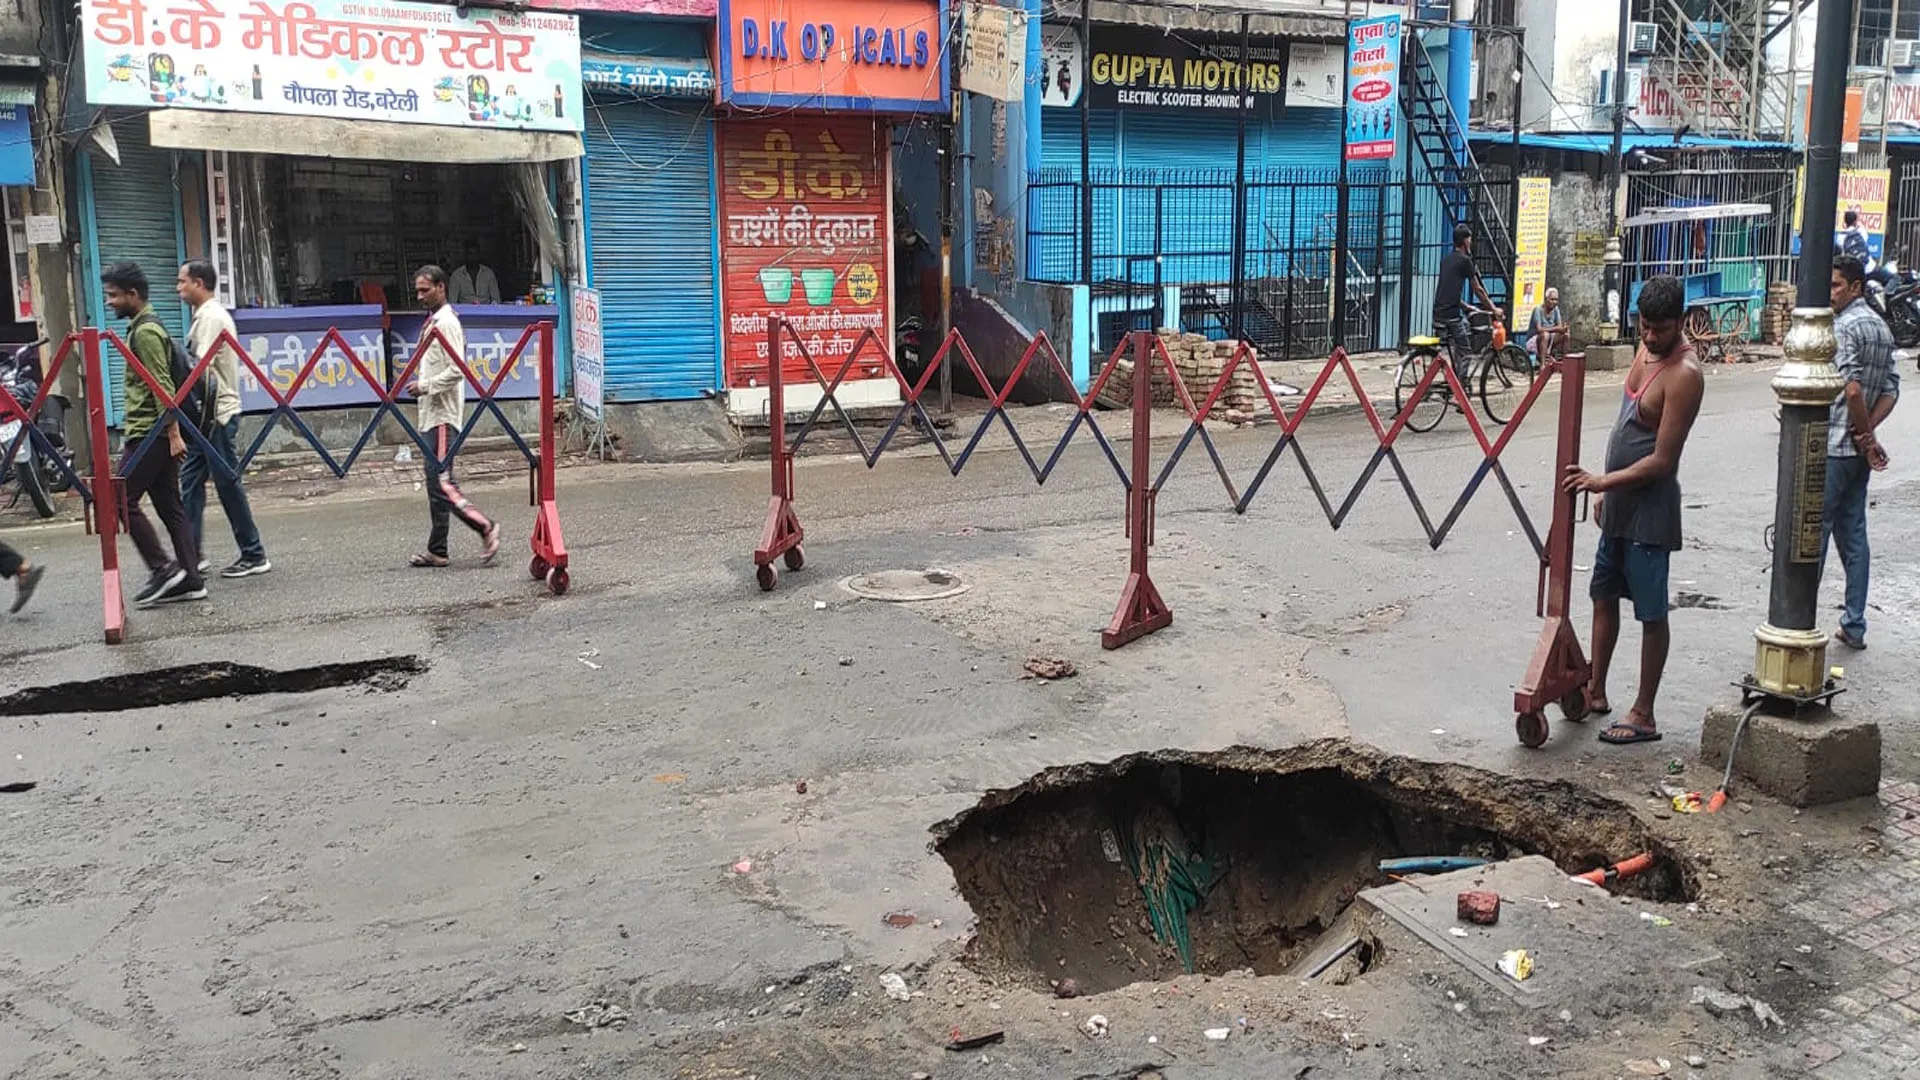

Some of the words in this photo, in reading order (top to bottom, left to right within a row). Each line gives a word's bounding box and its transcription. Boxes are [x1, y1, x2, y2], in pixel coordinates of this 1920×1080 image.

[239, 2, 428, 66] मेडिकल
[436, 20, 535, 73] स्टोर
[742, 18, 789, 61] D.K
[801, 23, 929, 68] OPICALS
[1353, 24, 1384, 45] गुप्ता
[1353, 45, 1386, 63] मोटर्स
[1092, 53, 1176, 89] GUPTA
[1183, 58, 1281, 93] MOTORS
[282, 80, 338, 106] चौपला
[1118, 90, 1160, 105] ELECTRIC
[1161, 92, 1202, 107] SCOOTER
[1888, 85, 1920, 121] SPITAL
[738, 128, 868, 199] डी.के.
[783, 204, 814, 246] की
[815, 214, 878, 255] दुकान
[730, 312, 760, 334] विदेशी
[831, 309, 844, 330] की
[808, 334, 824, 356] की
[826, 331, 855, 355] जाँच
